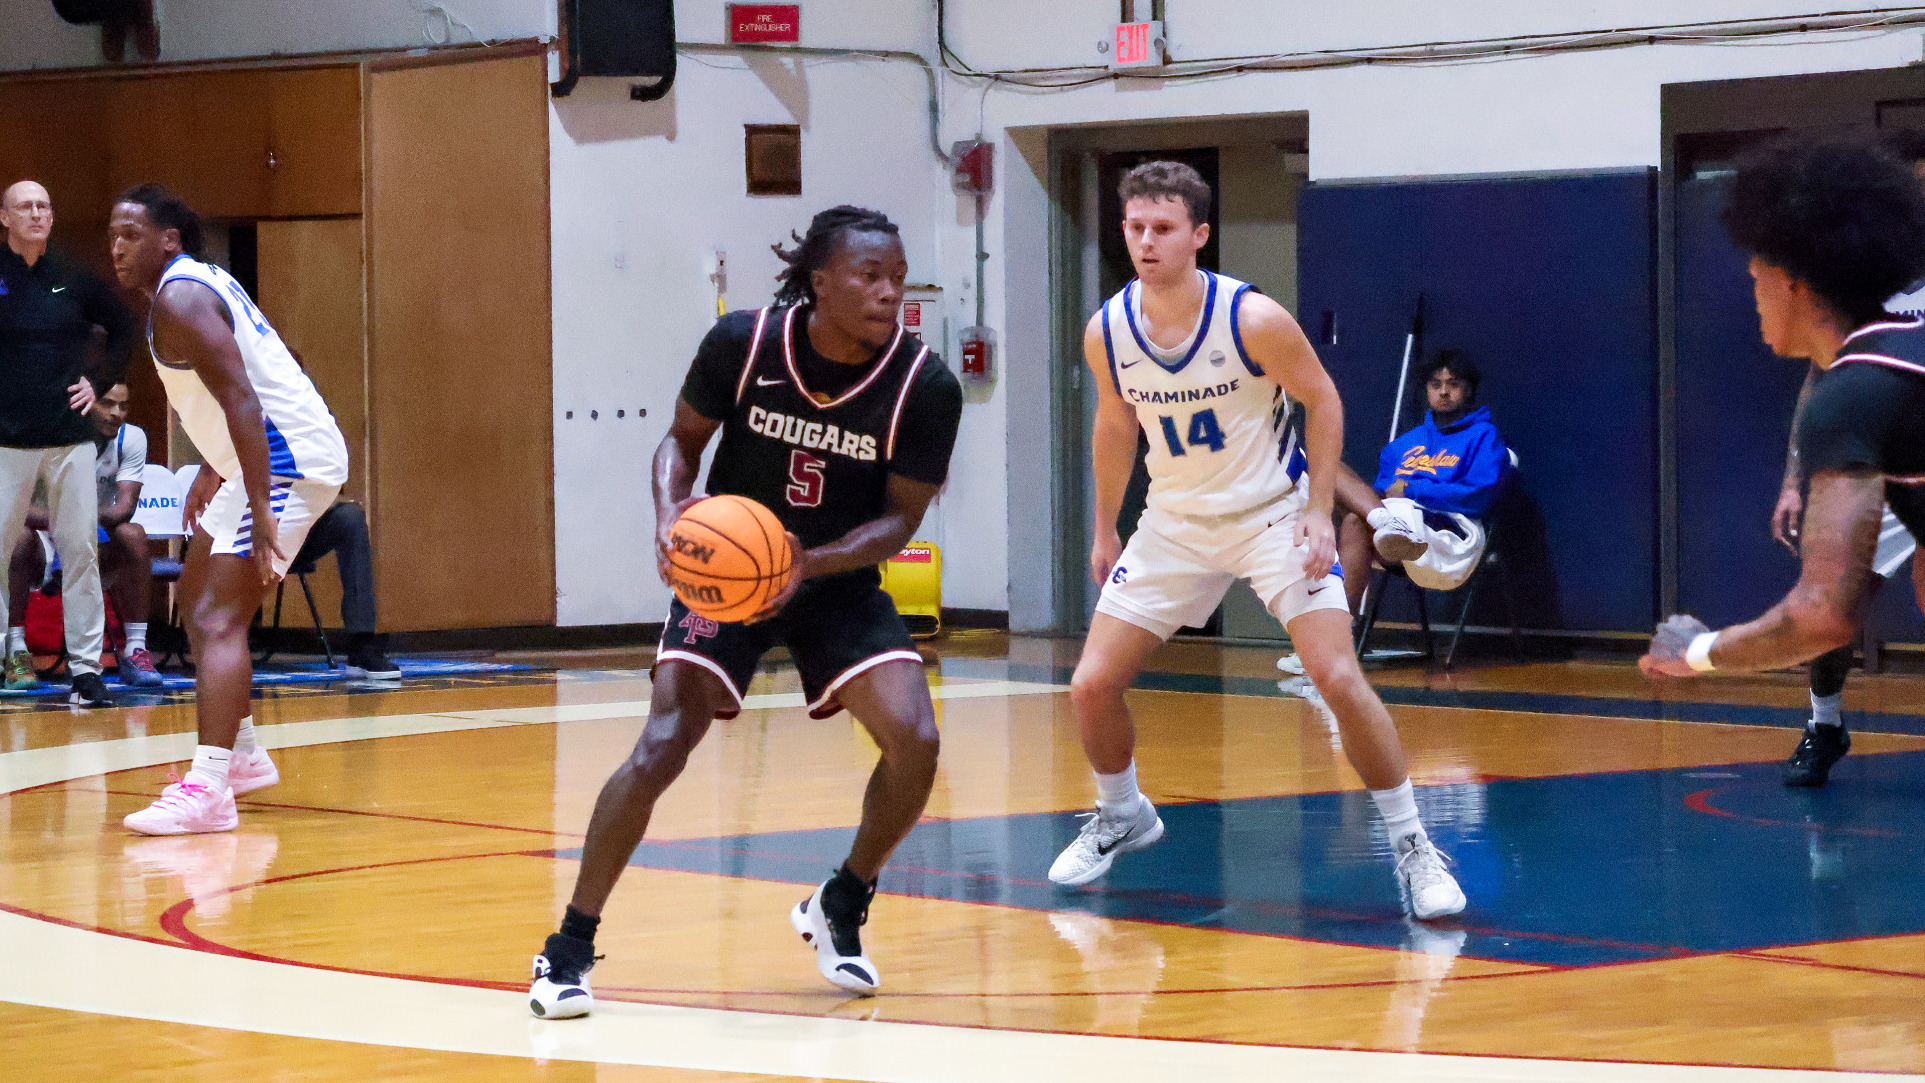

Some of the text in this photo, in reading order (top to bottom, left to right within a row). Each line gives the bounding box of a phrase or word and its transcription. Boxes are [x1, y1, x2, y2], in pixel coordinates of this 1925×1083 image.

[740, 23, 791, 32] EXTINGUISHER
[757, 14, 773, 22] FIRE
[1116, 23, 1150, 63] EXIT
[1127, 379, 1240, 404] CHAMINADE
[748, 405, 878, 461] COUGARS
[1158, 408, 1227, 457] 14
[786, 449, 827, 507] 5
